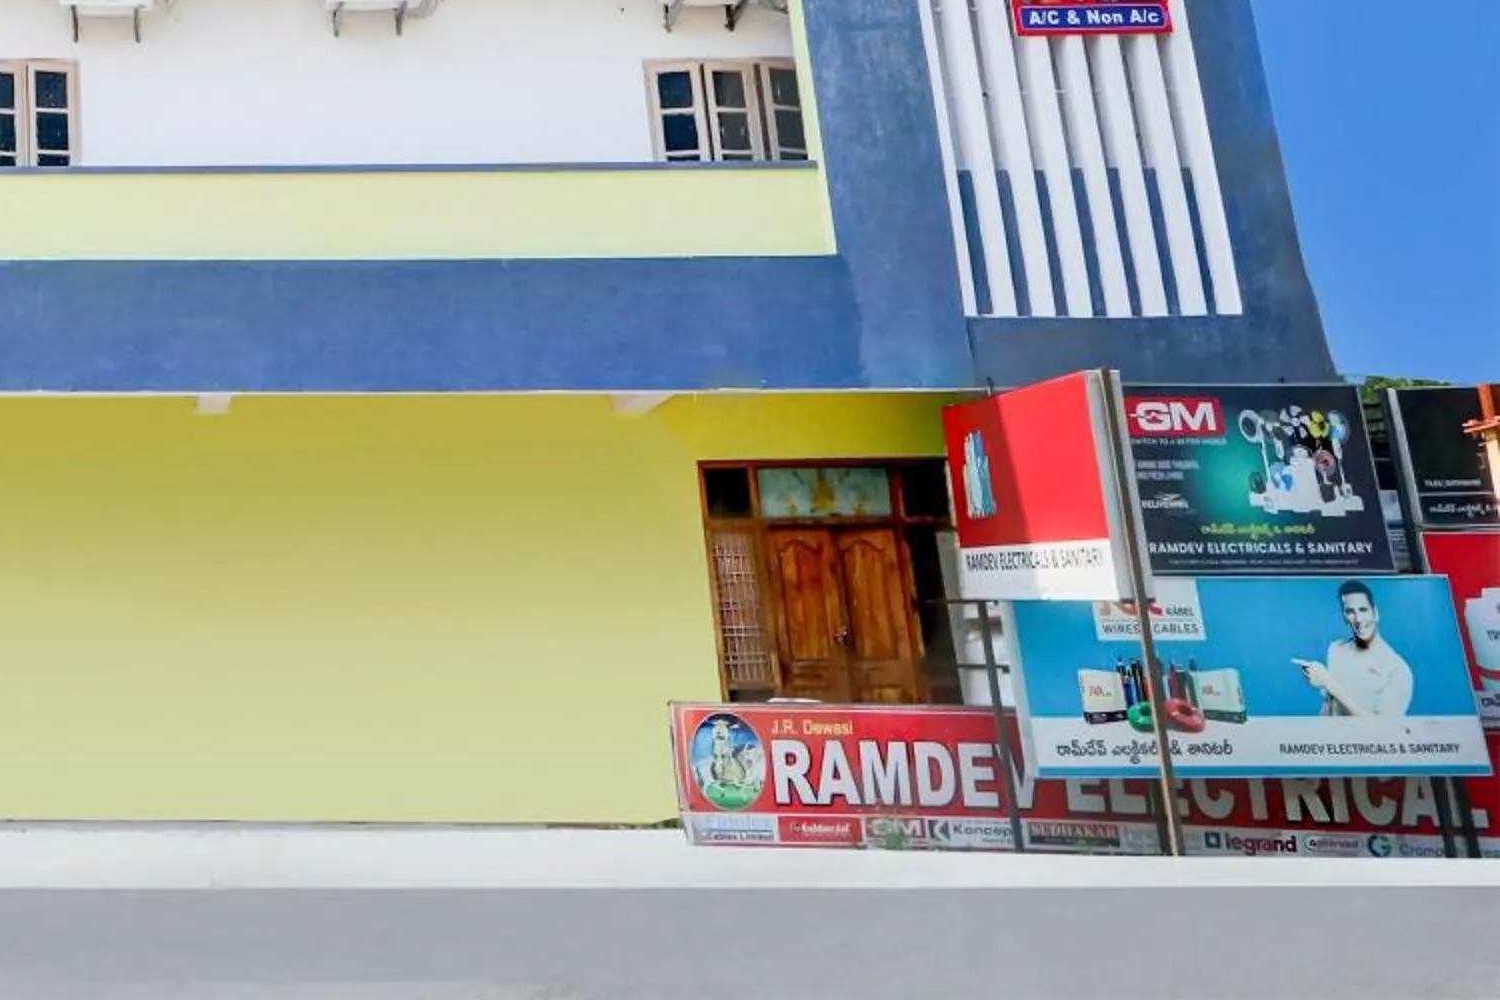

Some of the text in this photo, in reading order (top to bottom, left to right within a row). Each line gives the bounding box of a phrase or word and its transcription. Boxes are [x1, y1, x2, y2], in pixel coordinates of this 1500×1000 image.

[1029, 10, 1060, 26] A/C
[1067, 9, 1081, 25] &
[1086, 9, 1124, 25] Non
[1134, 401, 1218, 432] GM
[1149, 541, 1373, 555] RAMDEV ELECTRICALS & SANITARY
[965, 551, 1000, 571] RAMDEV
[1102, 622, 1200, 634] WIRES CABLES
[771, 719, 854, 735] J.R. Dewasi
[1279, 743, 1325, 755] RAMDEV
[1326, 743, 1398, 755] ELECTRICALS
[1409, 743, 1460, 753] SANITARY
[771, 738, 1036, 809] RAMDEV
[953, 823, 1014, 838] Koncep
[1225, 833, 1298, 856] legrand
